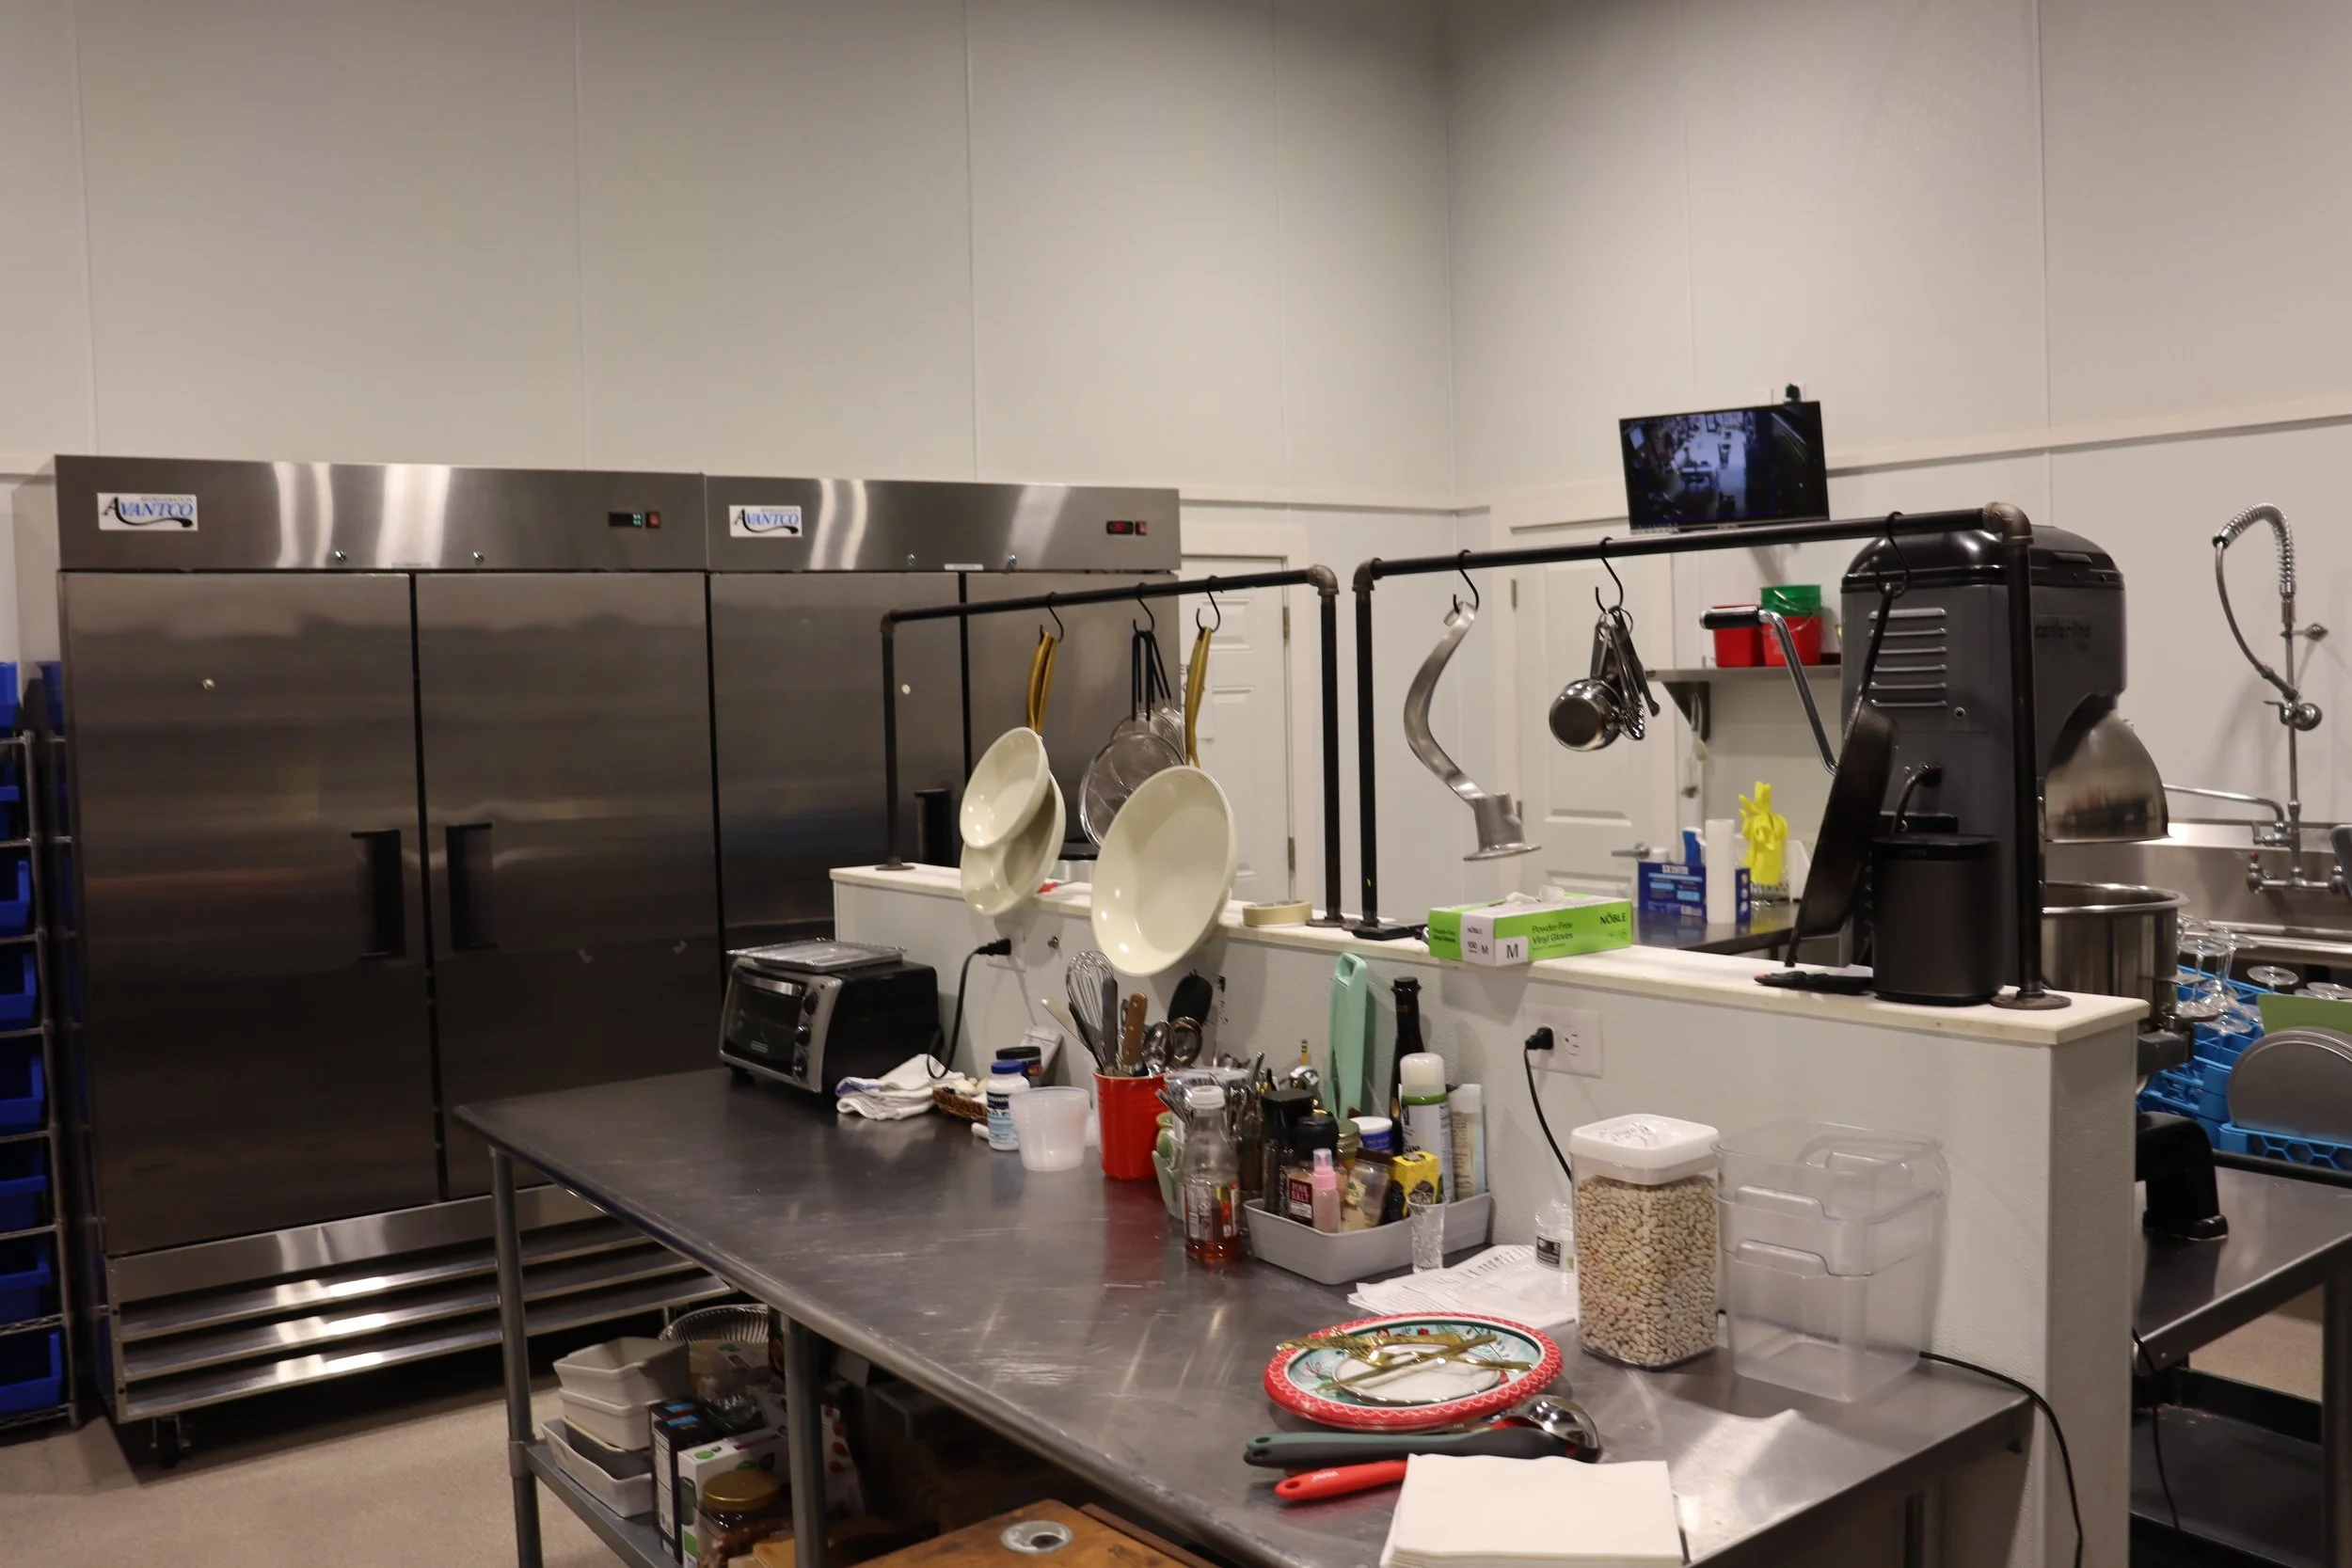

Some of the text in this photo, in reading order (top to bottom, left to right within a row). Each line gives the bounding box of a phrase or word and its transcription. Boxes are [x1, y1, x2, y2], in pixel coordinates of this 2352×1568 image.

[102, 497, 194, 528] AVANTCO
[733, 508, 800, 534] AVANTCO
[1532, 921, 1573, 934] Powder-Free
[1532, 932, 1573, 945] Vinyl Gloves
[1506, 942, 1518, 958] M
